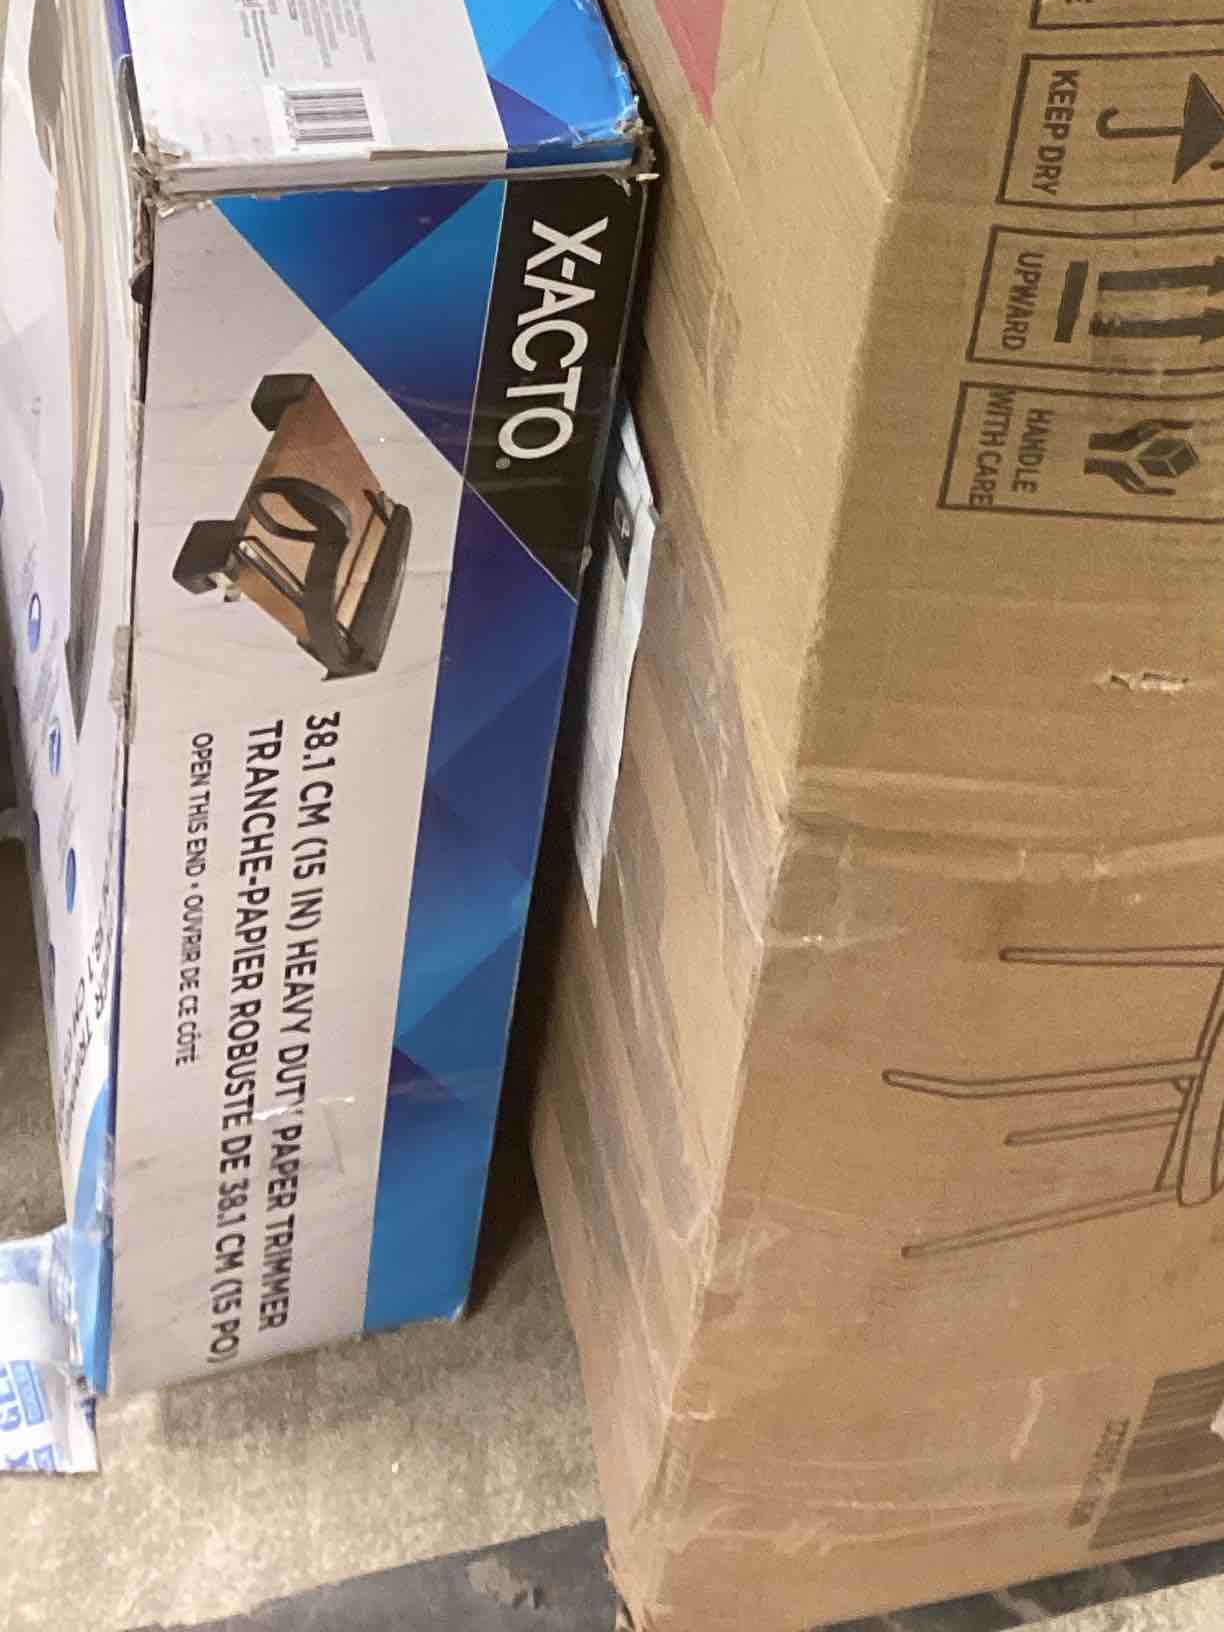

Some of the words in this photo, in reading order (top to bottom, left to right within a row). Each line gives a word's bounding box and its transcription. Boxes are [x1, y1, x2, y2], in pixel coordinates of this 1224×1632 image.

[1042, 69, 1081, 141] KEEP
[1030, 145, 1067, 196] DRY
[1001, 251, 1045, 352] UPWARD
[497, 216, 609, 461] X-ACTO
[978, 387, 1017, 447] WITH
[968, 449, 1002, 507] CARE
[1010, 408, 1054, 494] HANDLE
[190, 732, 214, 788] OPEN
[301, 710, 341, 772] 38.1
[187, 790, 211, 835] THIS
[298, 780, 334, 828] CM
[184, 837, 208, 878] END
[231, 718, 284, 994] TRANCHE-PAPIER
[291, 837, 329, 881] (15
[181, 894, 205, 964] OUVRIR
[285, 887, 324, 932] IN)
[177, 994, 199, 1019] CE
[179, 966, 201, 992] DE
[279, 938, 319, 1035] HEAVY
[222, 999, 262, 1131] ROBUSTE
[218, 1134, 254, 1175] DE
[266, 1124, 303, 1214] PAPER
[216, 1177, 250, 1229] 38.1
[214, 1233, 246, 1274] CM
[258, 1212, 296, 1332] TRIMMER
[209, 1278, 244, 1315] (15
[206, 1317, 241, 1364] PO)
